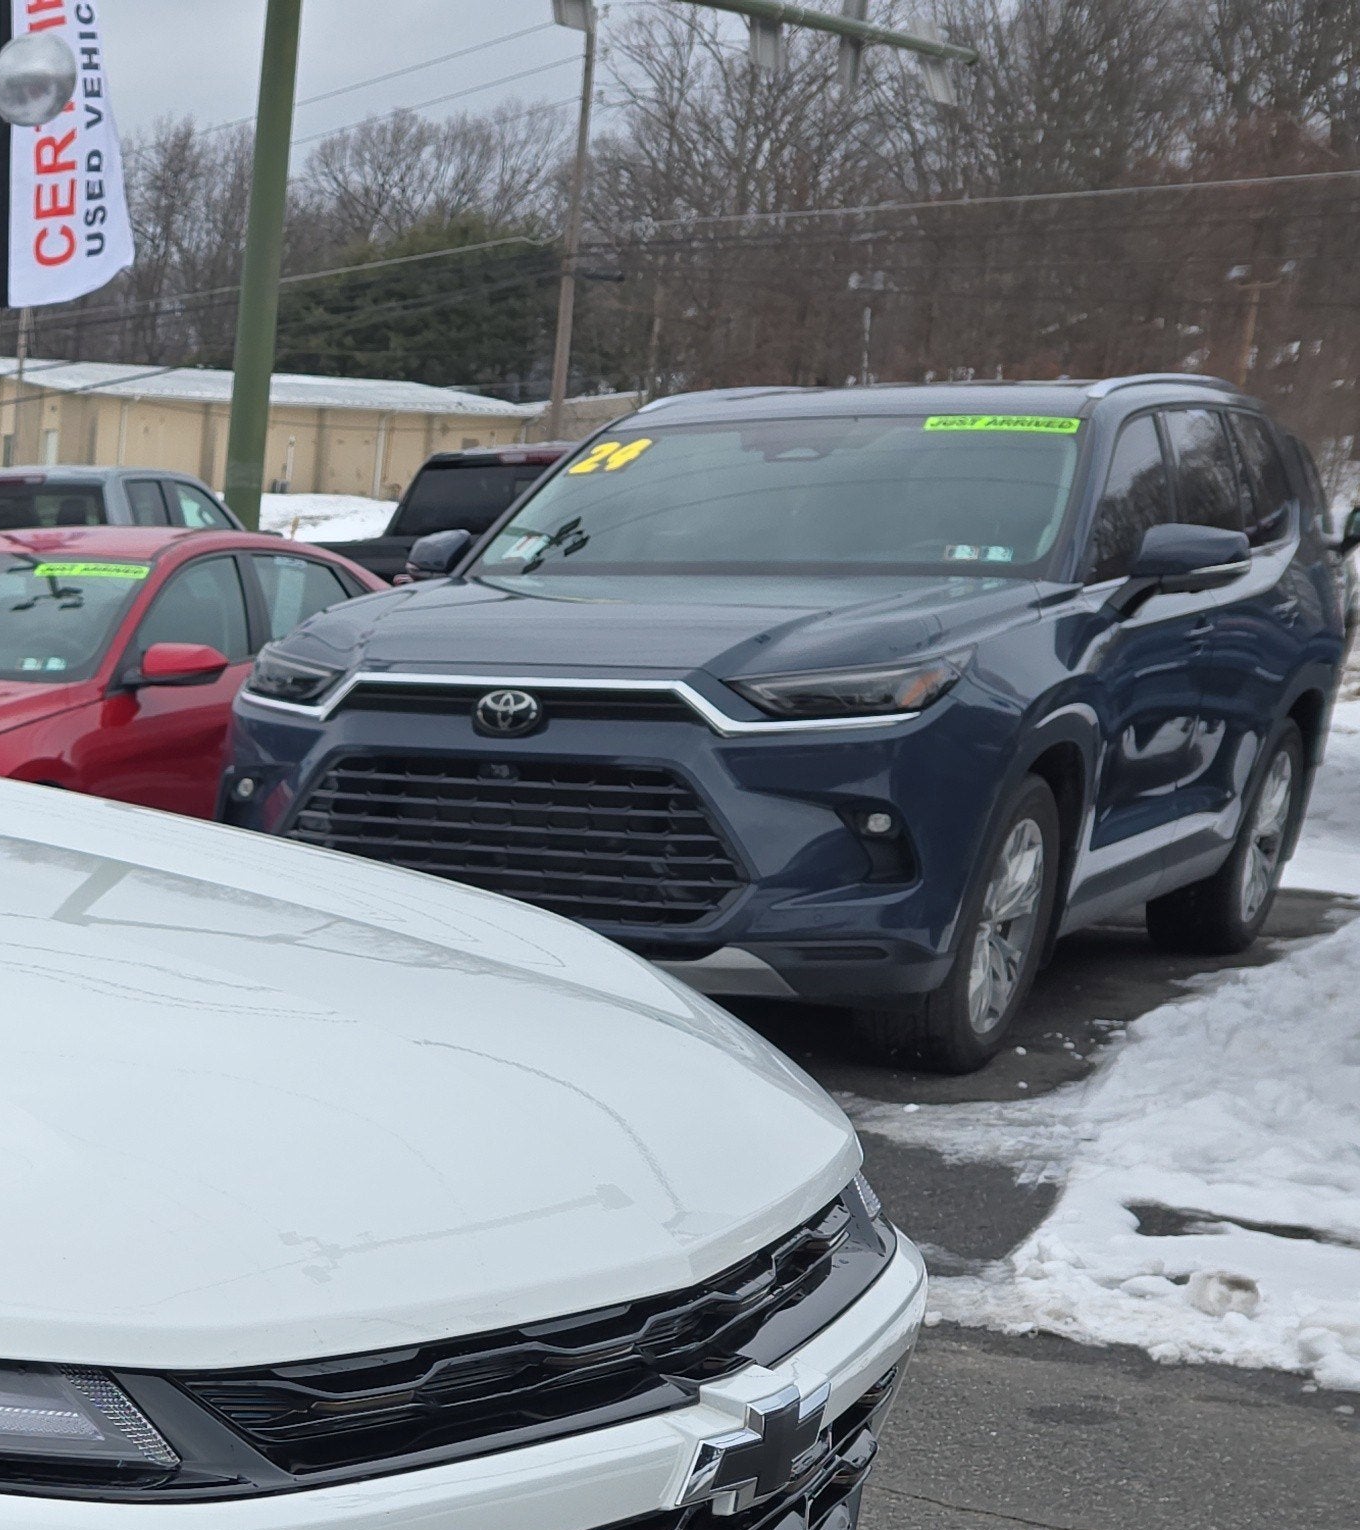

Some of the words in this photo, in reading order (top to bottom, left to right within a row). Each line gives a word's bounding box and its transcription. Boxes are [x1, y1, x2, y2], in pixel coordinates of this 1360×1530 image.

[75, 3, 104, 129] VEHIC
[84, 149, 107, 257] USED
[568, 438, 653, 474] 24
